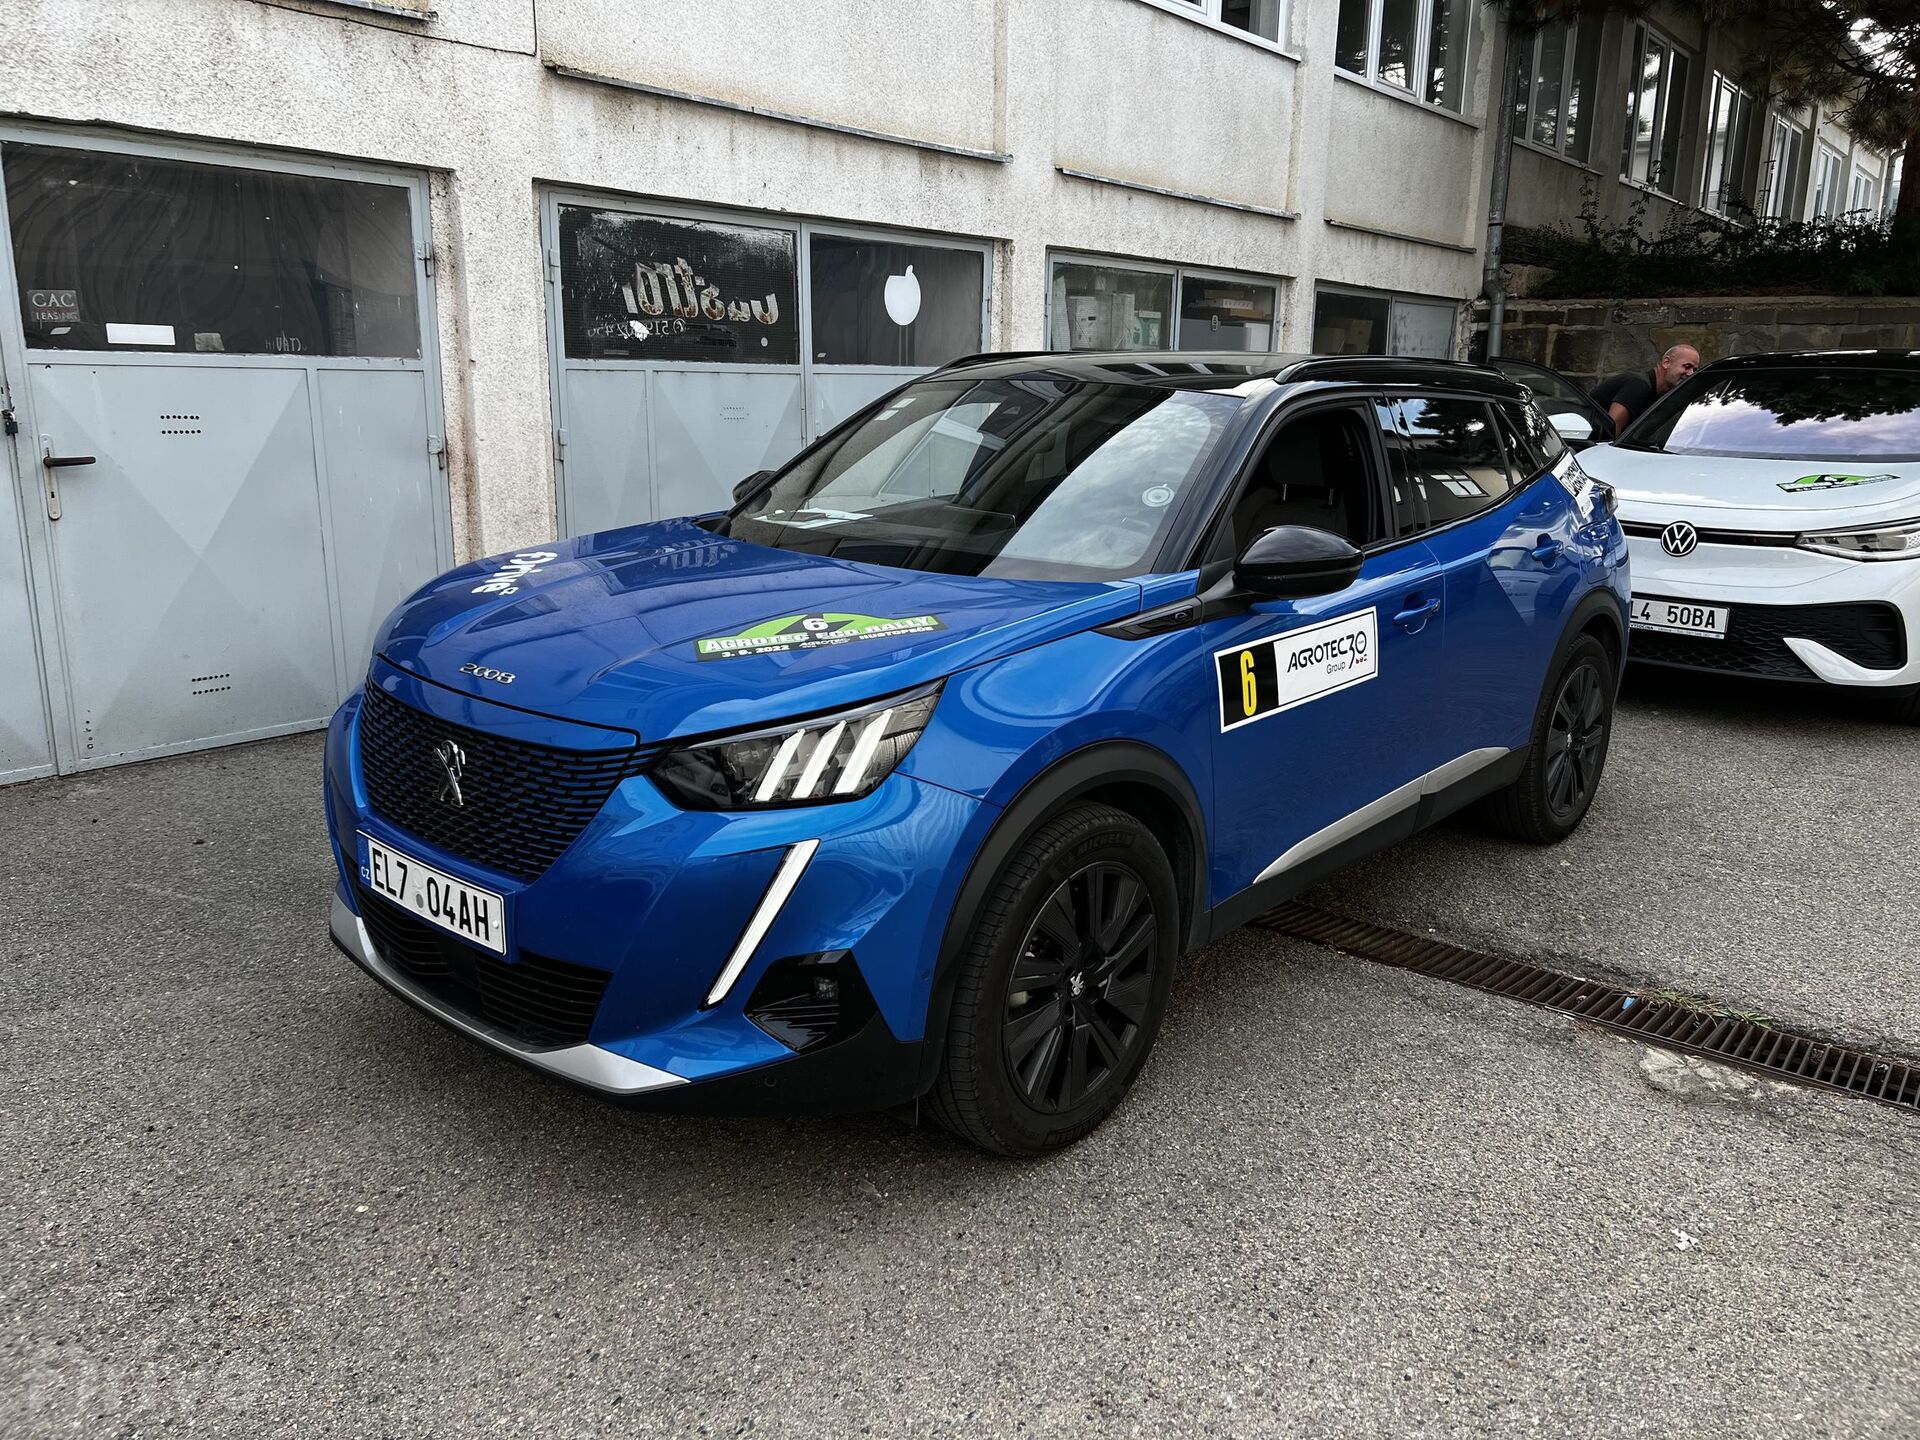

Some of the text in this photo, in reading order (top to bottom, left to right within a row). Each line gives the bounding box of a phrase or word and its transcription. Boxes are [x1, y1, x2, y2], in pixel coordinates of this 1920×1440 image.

[32, 293, 75, 308] CAC
[802, 618, 828, 631] 6
[1667, 605, 1715, 629] 50BA
[705, 616, 929, 652] AGROTEC ECO RALLY
[755, 645, 791, 654] 2022
[459, 662, 516, 684] 2008
[1240, 650, 1257, 717] 6
[1287, 637, 1348, 673] AGROTEC
[1326, 661, 1346, 675] Group
[360, 848, 489, 941] CZ EL7 04AH
